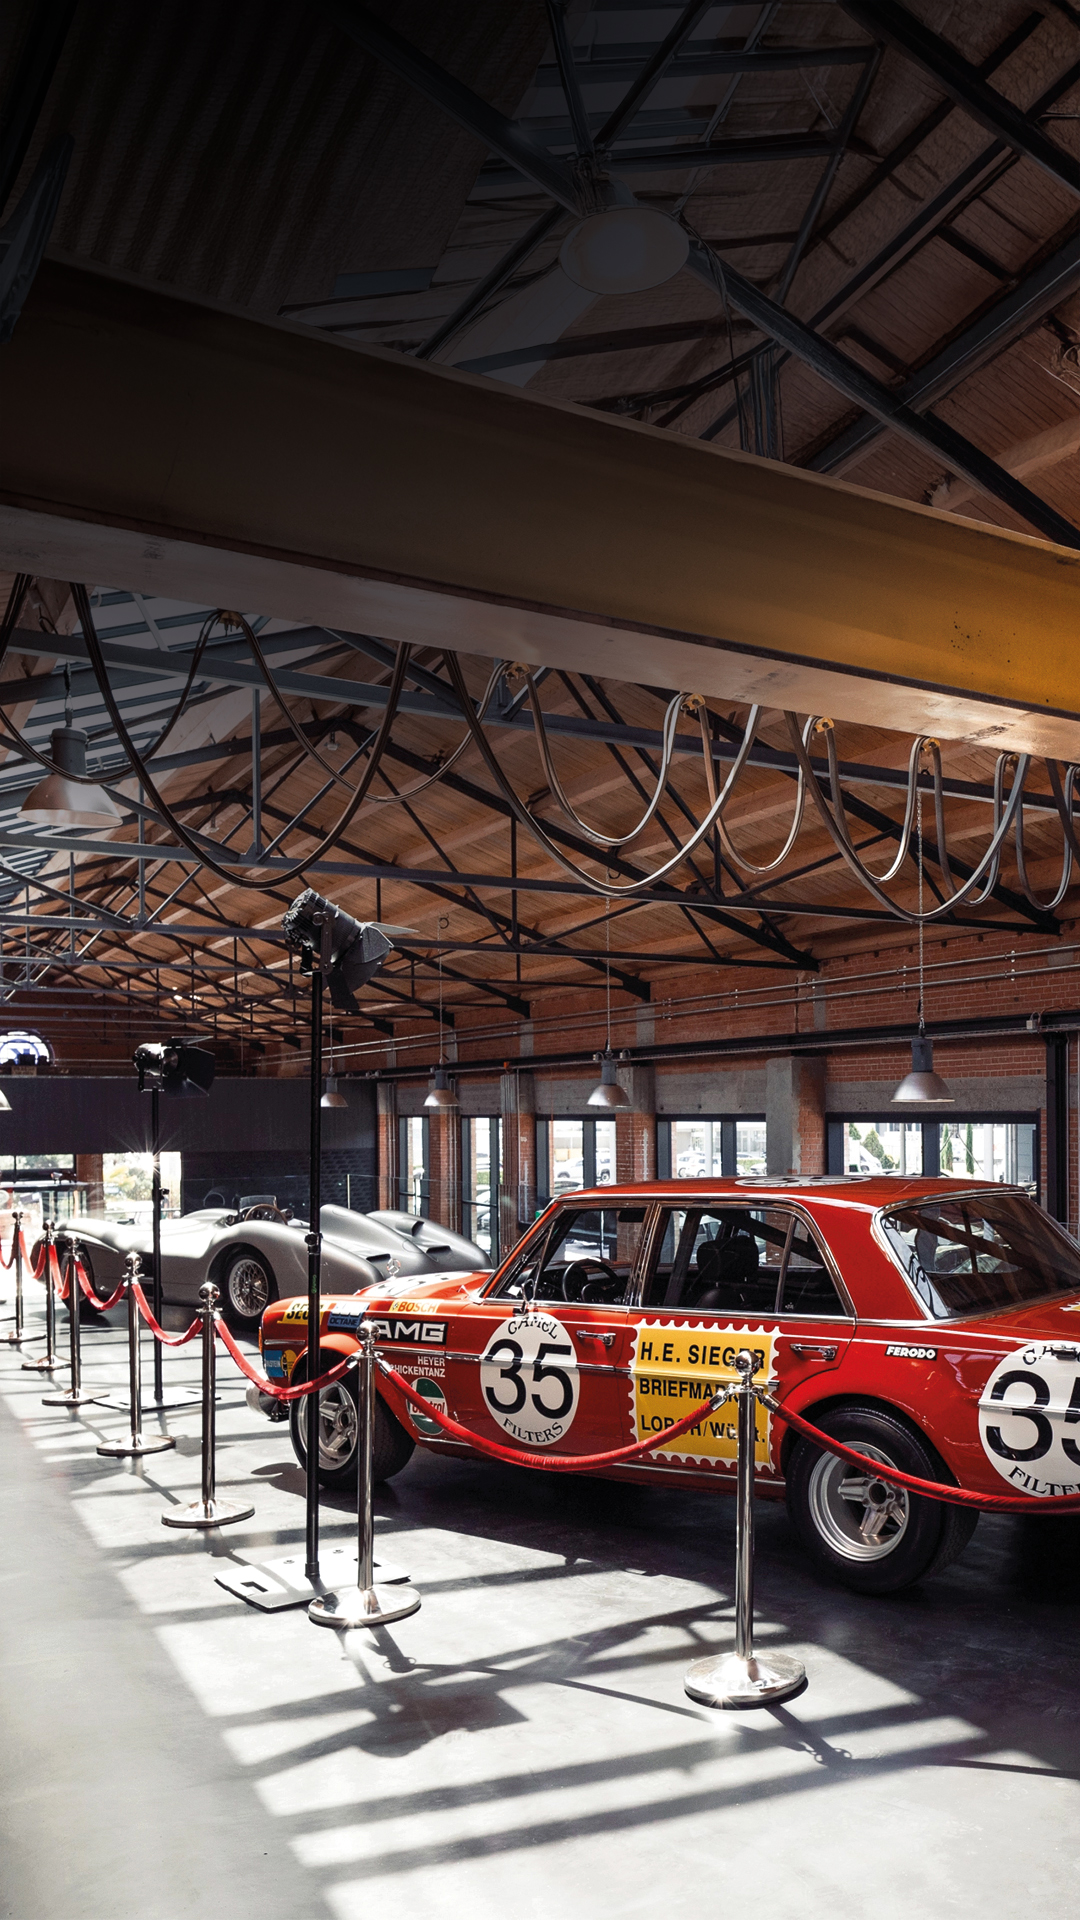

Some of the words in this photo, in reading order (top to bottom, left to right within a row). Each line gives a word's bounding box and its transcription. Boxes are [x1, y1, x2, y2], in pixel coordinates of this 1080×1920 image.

[398, 1301, 436, 1313] BOSCH
[329, 1317, 358, 1327] OCTANE
[374, 1320, 446, 1342] AMG
[417, 1356, 446, 1367] HEYER
[640, 1341, 681, 1363] H.E.
[687, 1344, 766, 1369] SIEGR
[886, 1345, 936, 1360] FERODO
[486, 1338, 574, 1420] 35
[503, 1417, 563, 1443] FILTERS
[1008, 1466, 1080, 1496] FILTE
